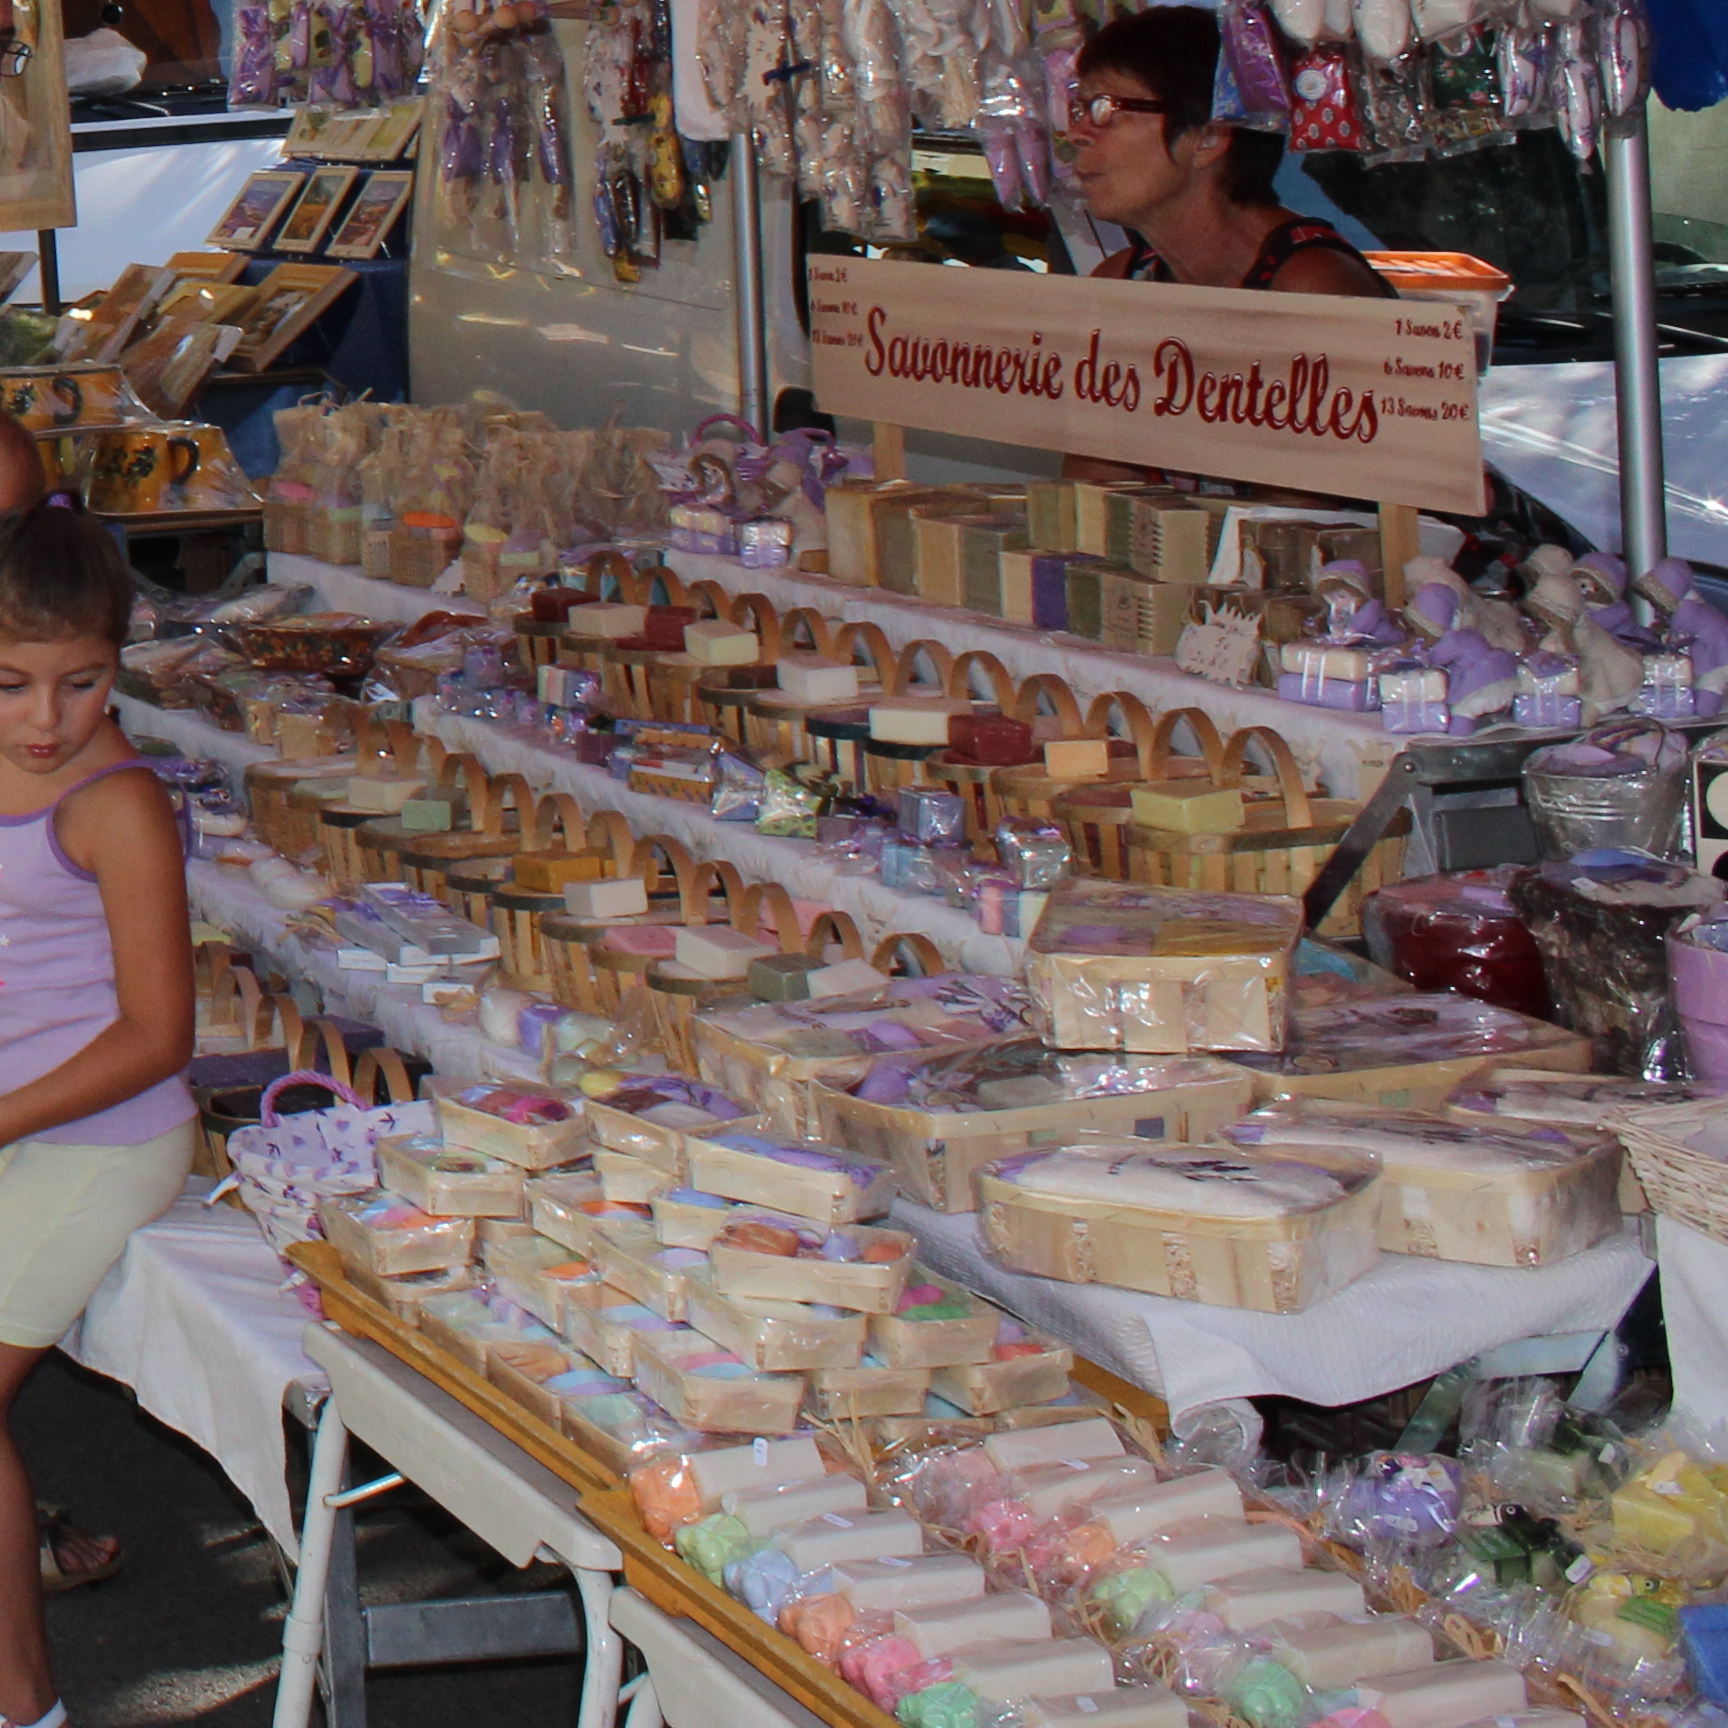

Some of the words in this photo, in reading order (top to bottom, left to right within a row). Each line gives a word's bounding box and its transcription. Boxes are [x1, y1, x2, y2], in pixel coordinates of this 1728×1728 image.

[865, 306, 1063, 400] Savonnerie
[1074, 328, 1141, 412] des
[1153, 336, 1379, 444] Dentelles
[1384, 358, 1393, 375] 6
[1395, 356, 1435, 378] Savons
[1381, 396, 1395, 415] 13
